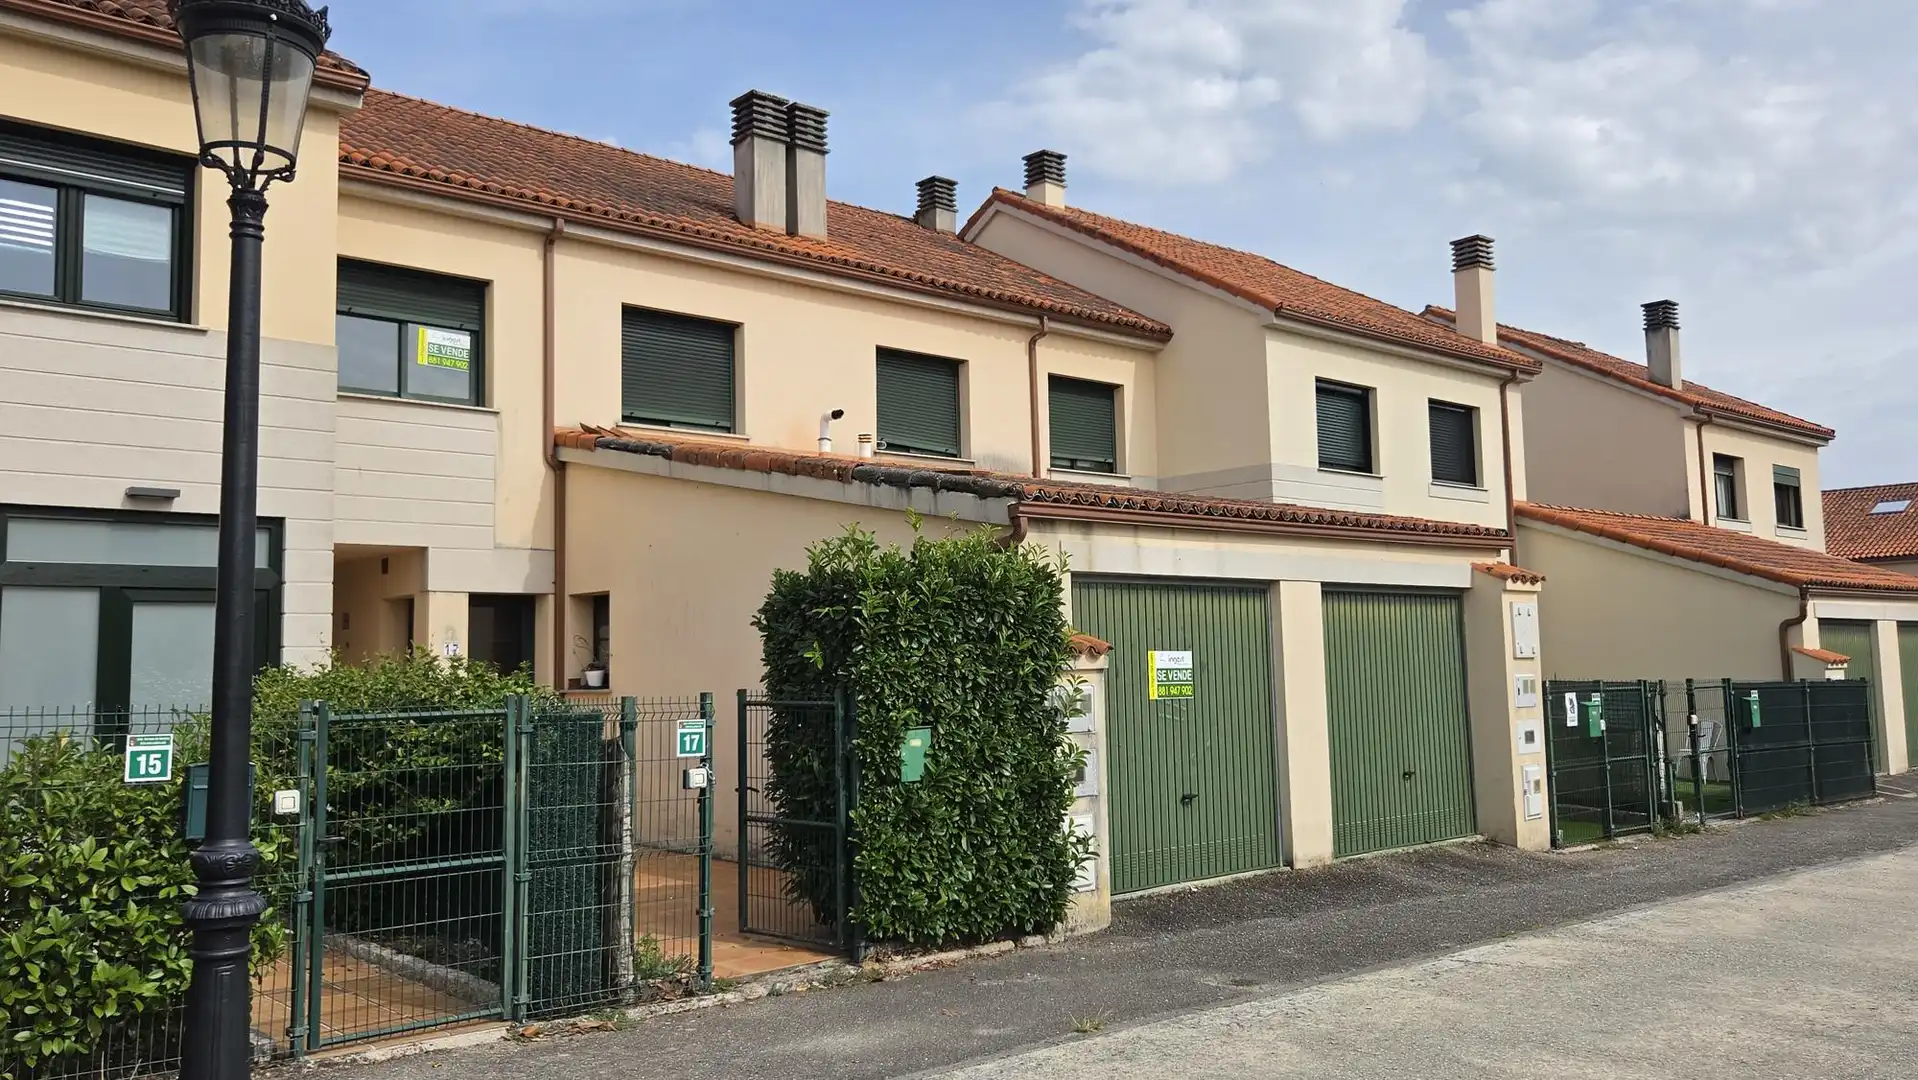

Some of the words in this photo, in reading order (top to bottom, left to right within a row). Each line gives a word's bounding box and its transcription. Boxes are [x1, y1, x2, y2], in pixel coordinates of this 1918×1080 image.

[428, 343, 440, 354] SE
[441, 344, 469, 358] VENDE
[428, 355, 440, 365] 881
[442, 358, 455, 367] 947
[455, 360, 469, 369] 902
[1157, 669, 1167, 681] SE
[1168, 669, 1192, 681] VENDE
[1158, 686, 1168, 696] 881
[1169, 685, 1181, 695] 947
[1181, 685, 1193, 695] 902
[683, 734, 700, 752] 17
[136, 753, 162, 775] 15
